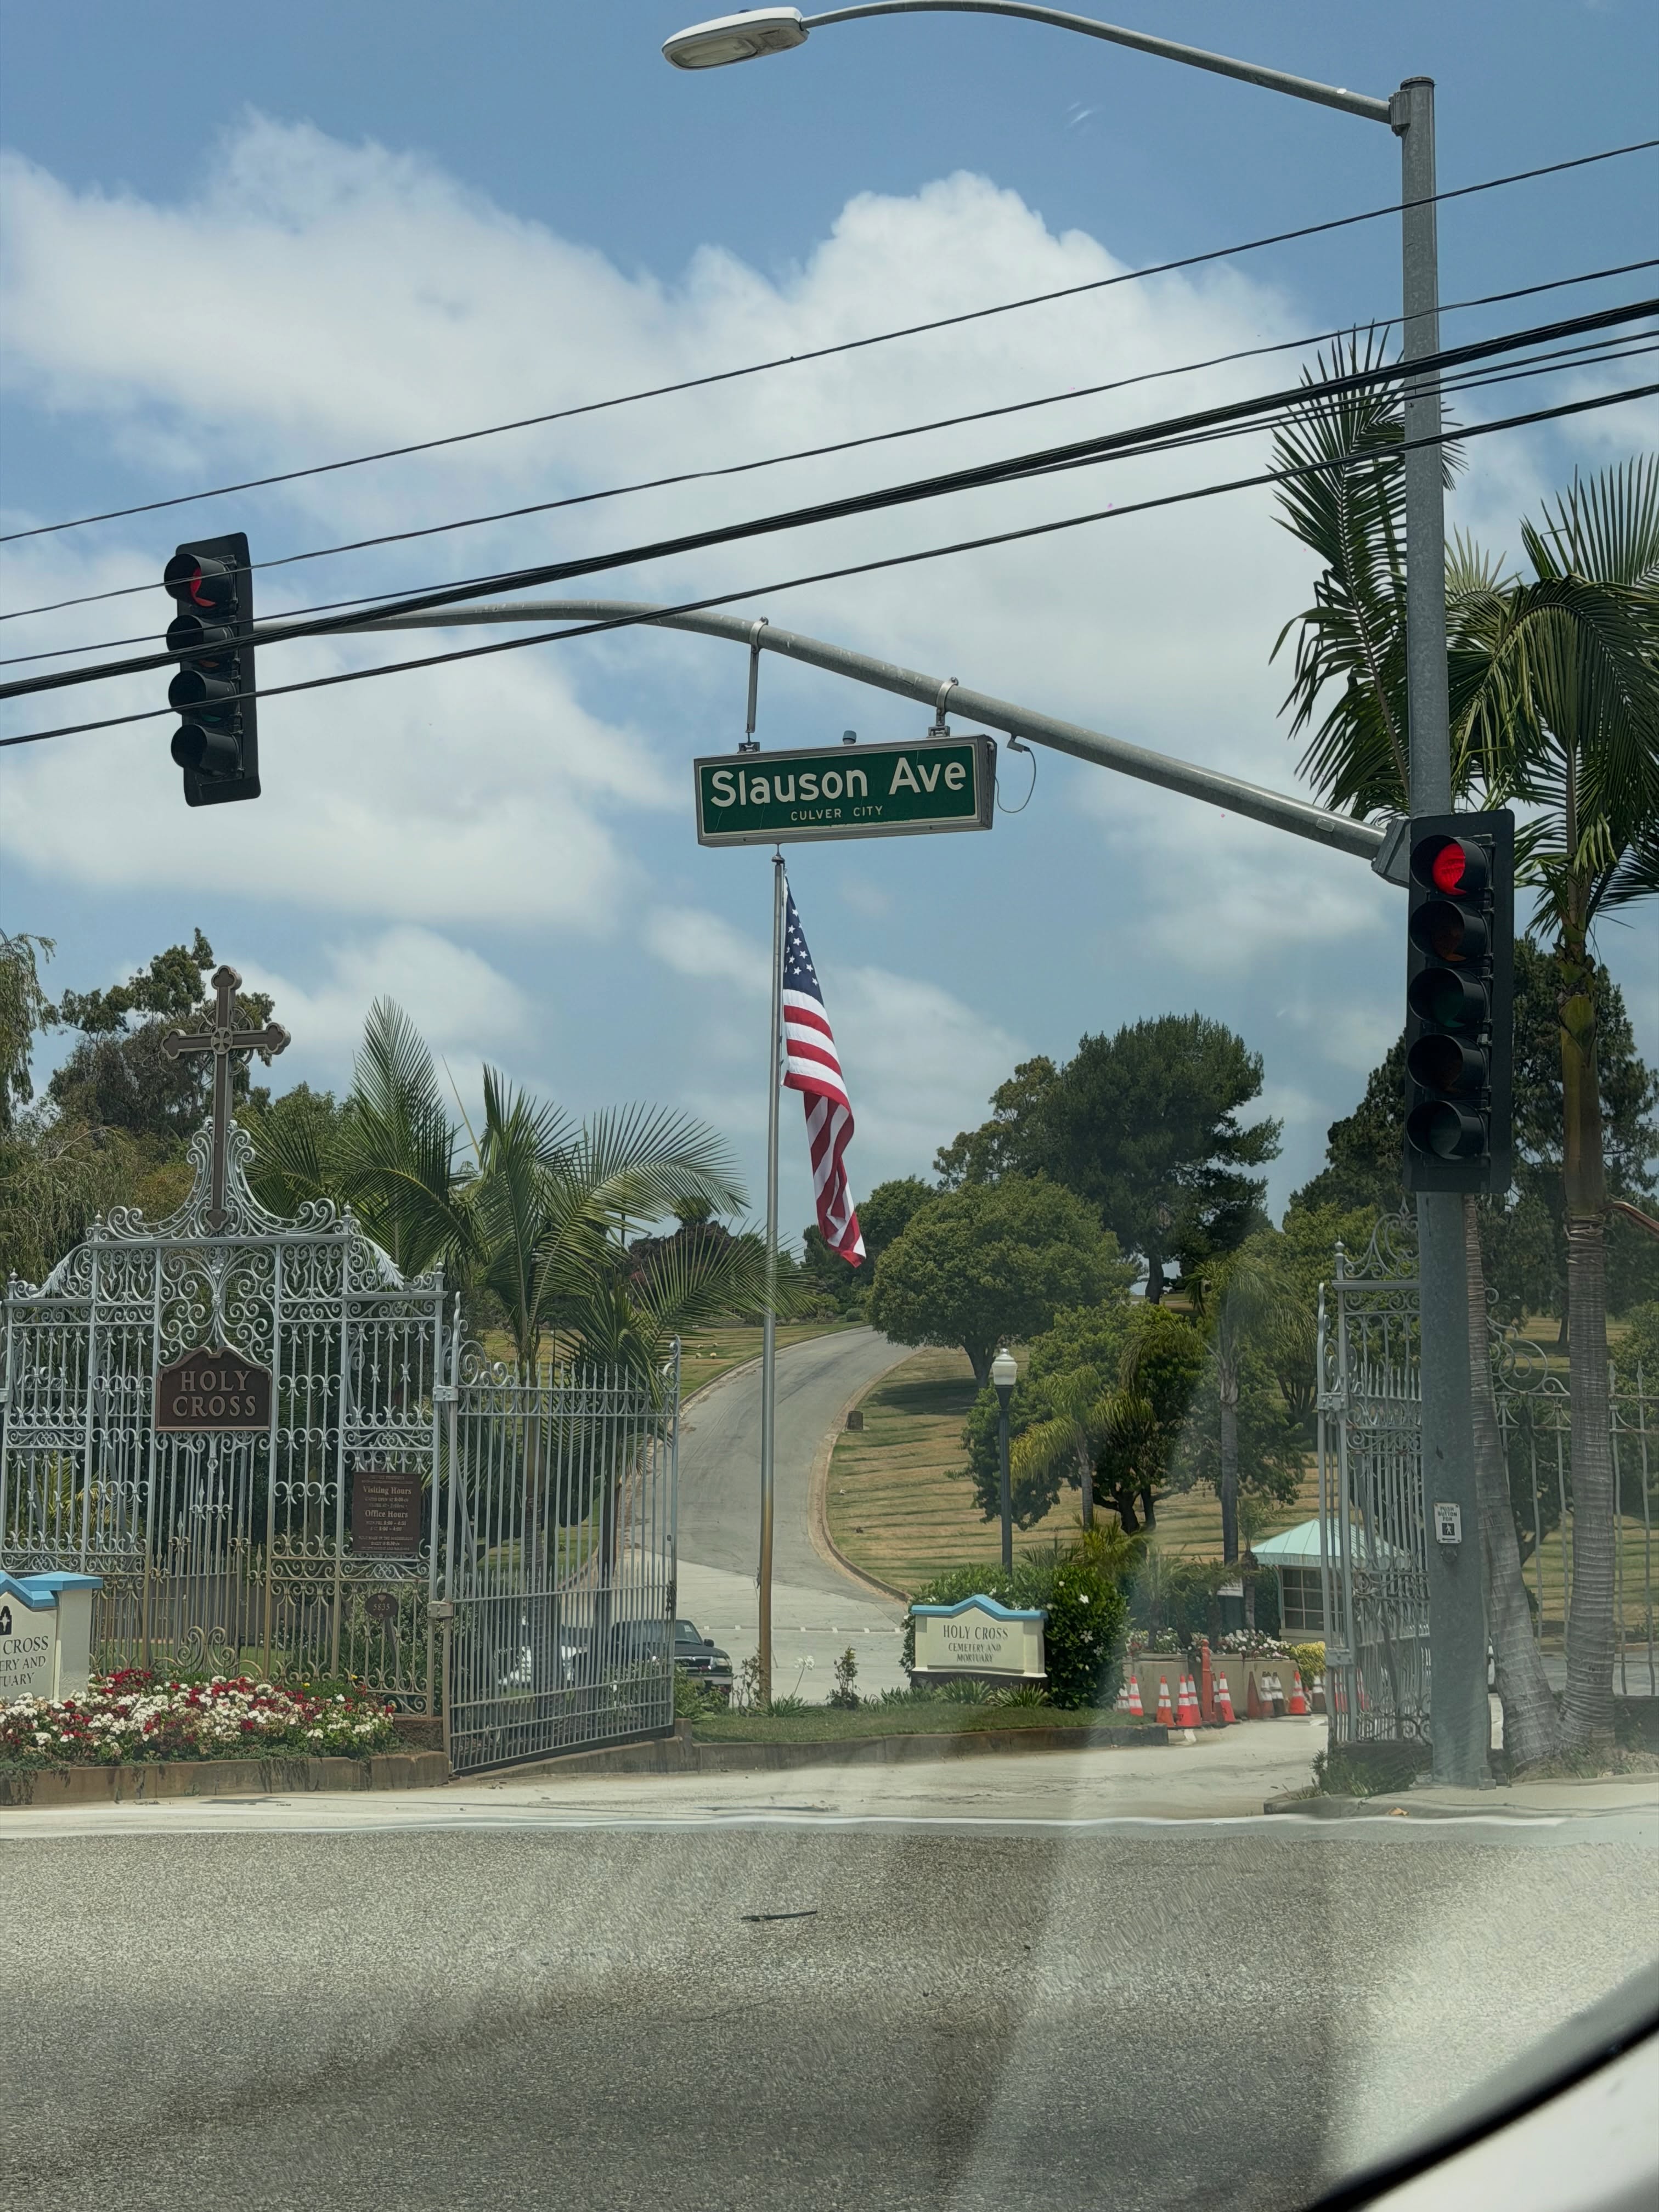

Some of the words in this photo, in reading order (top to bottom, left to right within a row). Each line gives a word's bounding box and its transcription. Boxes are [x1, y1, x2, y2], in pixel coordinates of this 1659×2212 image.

[710, 769, 868, 807] Slauson
[889, 757, 966, 795] Ave
[791, 808, 842, 821] CULVER
[853, 805, 883, 817] CITY
[180, 1370, 251, 1391] HOLY
[173, 1396, 256, 1417] CROSS
[363, 1486, 390, 1495] Visiting
[943, 1624, 970, 1639] HOLY
[975, 1627, 1008, 1641] CROSS
[3, 1635, 48, 1655] CROSS
[948, 1643, 984, 1652] CEMETERY
[22, 1656, 46, 1669] AND
